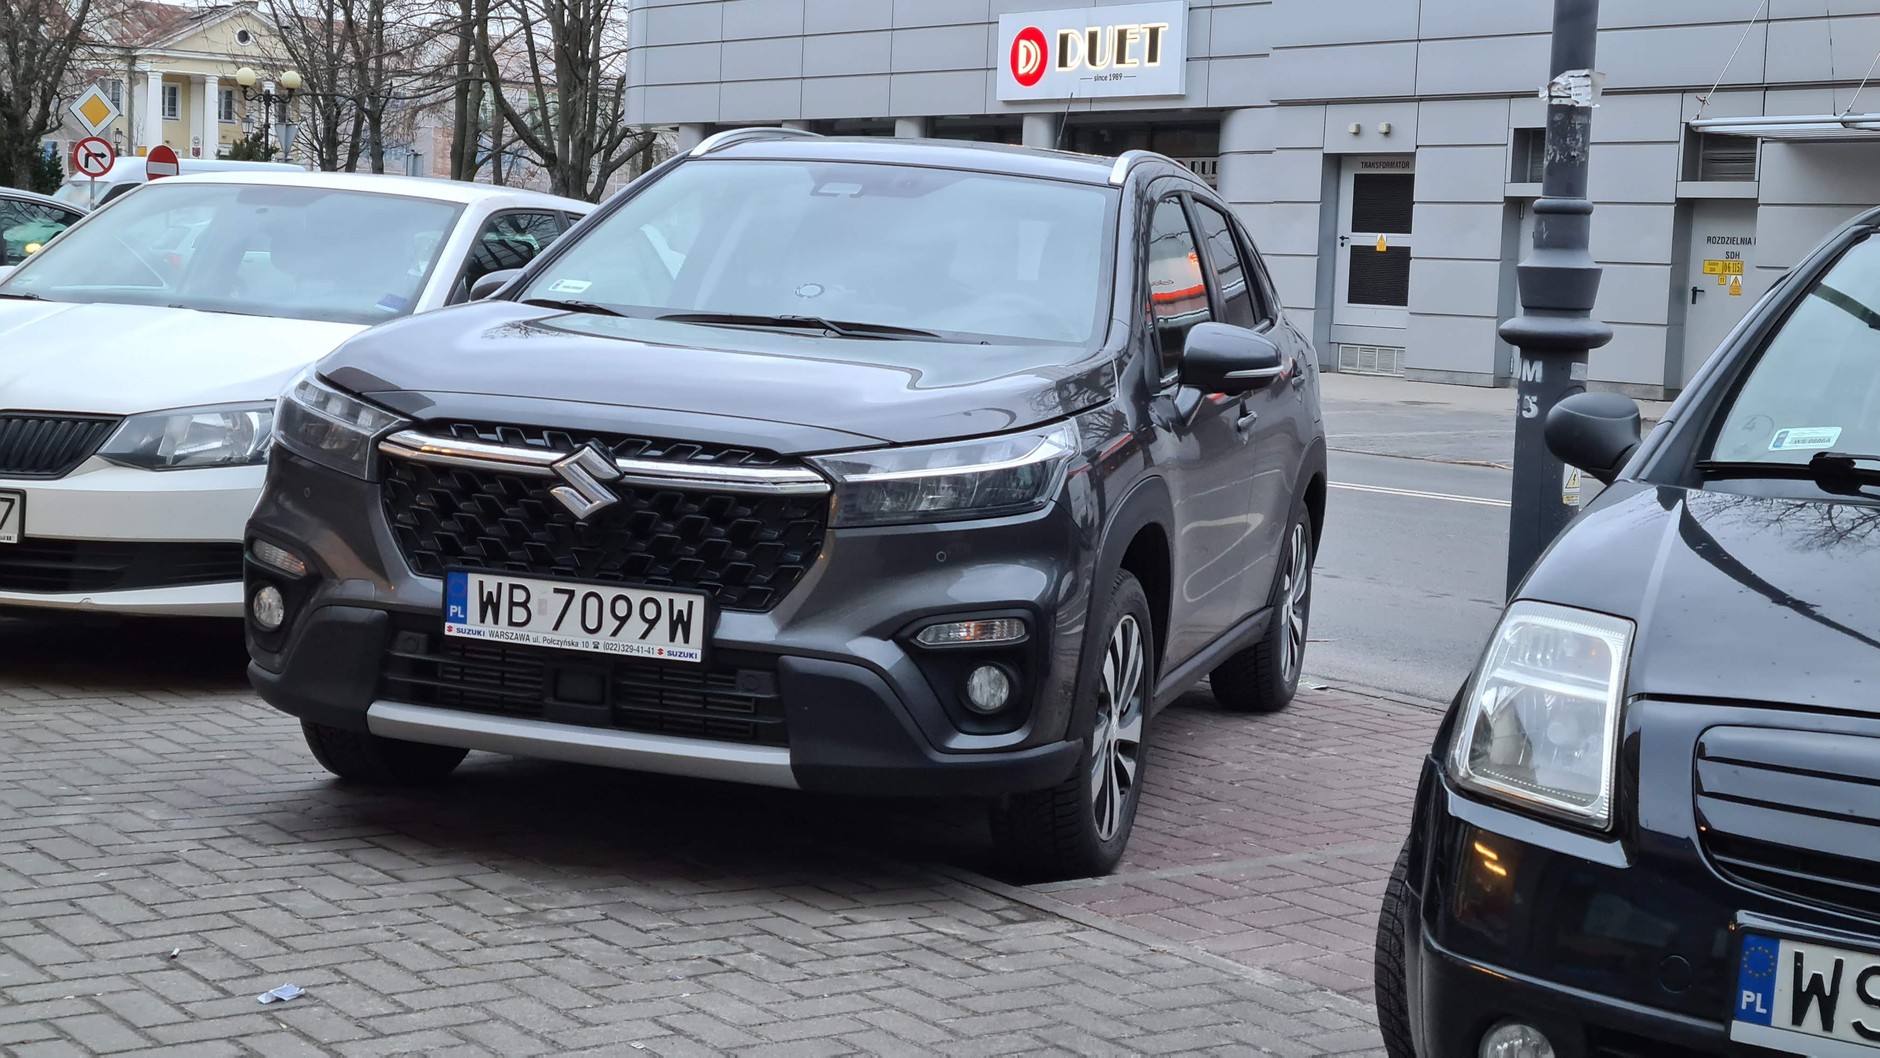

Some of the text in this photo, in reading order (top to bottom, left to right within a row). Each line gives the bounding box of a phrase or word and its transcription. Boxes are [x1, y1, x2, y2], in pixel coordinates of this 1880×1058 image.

[1056, 22, 1168, 72] DUET
[1094, 73, 1123, 82] since 1989
[1361, 161, 1410, 169] TRANSFORMATOR
[1706, 236, 1752, 246] ROZDZIELNIA
[1725, 251, 1740, 260] SDH
[450, 605, 465, 619] PL
[478, 580, 694, 645] WB 7099W
[456, 627, 486, 637] SUZUKI
[488, 629, 531, 643] WARSZAWA
[532, 636, 541, 644] ul.
[581, 640, 590, 649] 10
[603, 641, 655, 656] (022)329-41-41
[666, 650, 698, 660] SUZUKI
[1741, 990, 1767, 1014] PL
